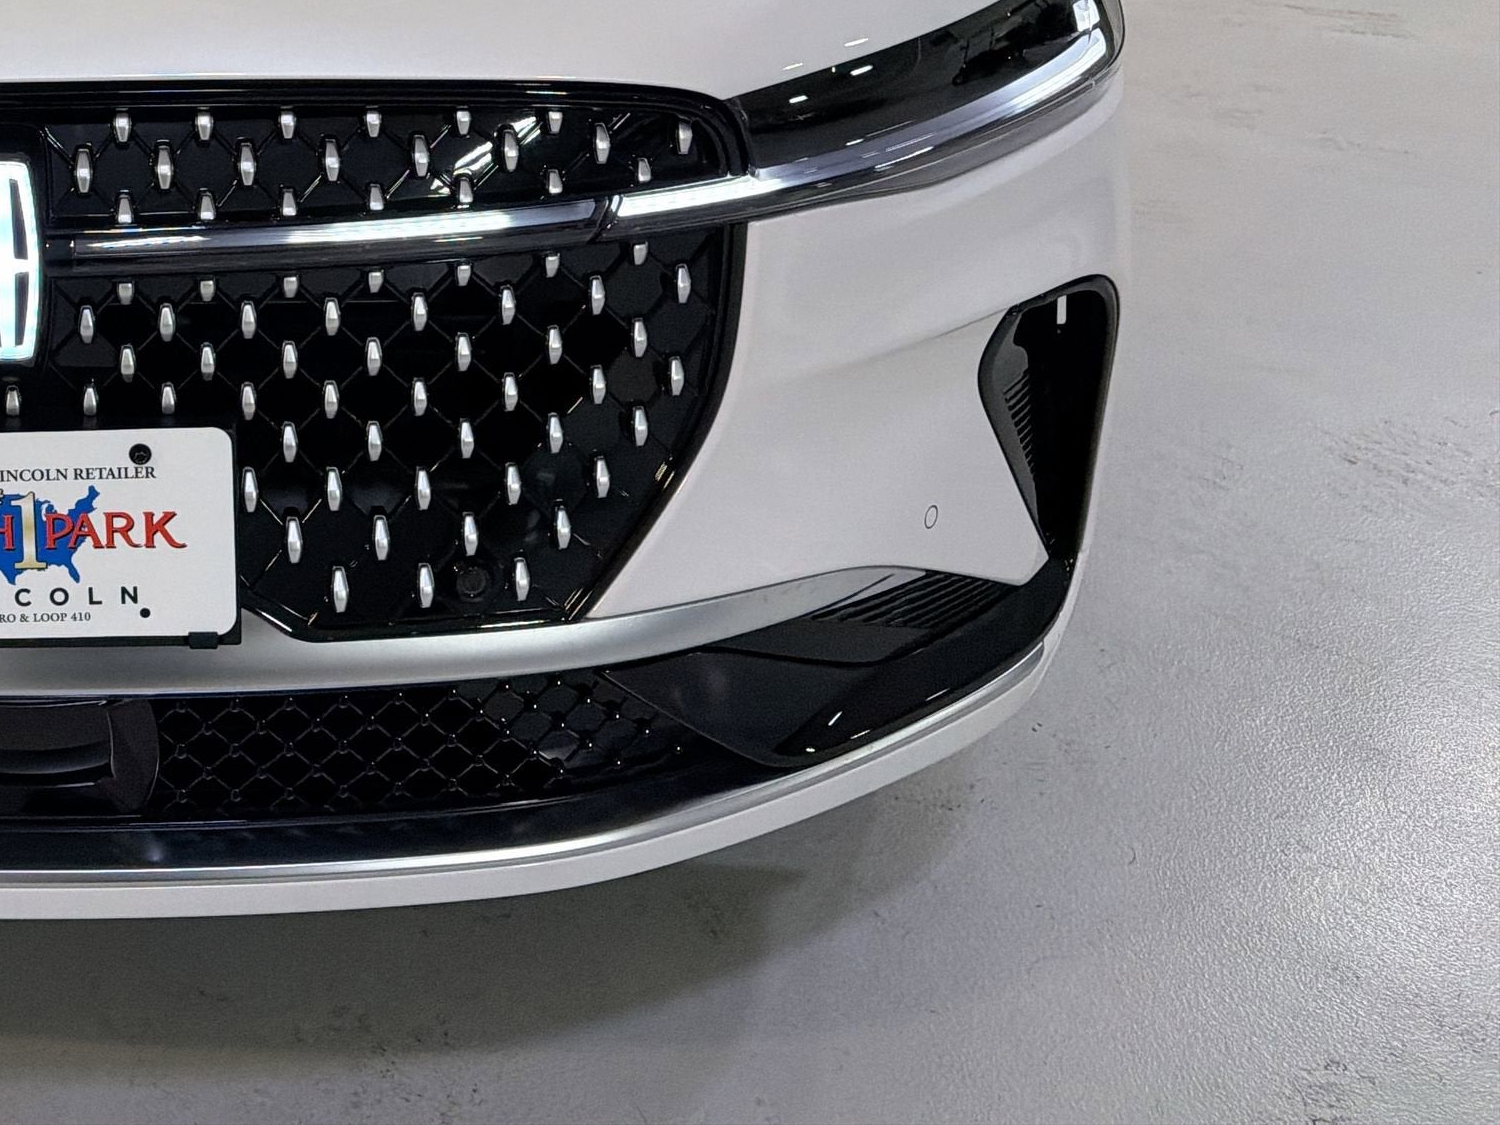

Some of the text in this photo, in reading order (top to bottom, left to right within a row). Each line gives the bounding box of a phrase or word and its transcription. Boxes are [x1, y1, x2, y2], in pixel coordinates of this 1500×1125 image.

[74, 465, 157, 481] RETAILER
[44, 511, 188, 550] PARK
[19, 613, 31, 624] &
[32, 612, 68, 624] LOOP
[71, 611, 92, 623] 410
